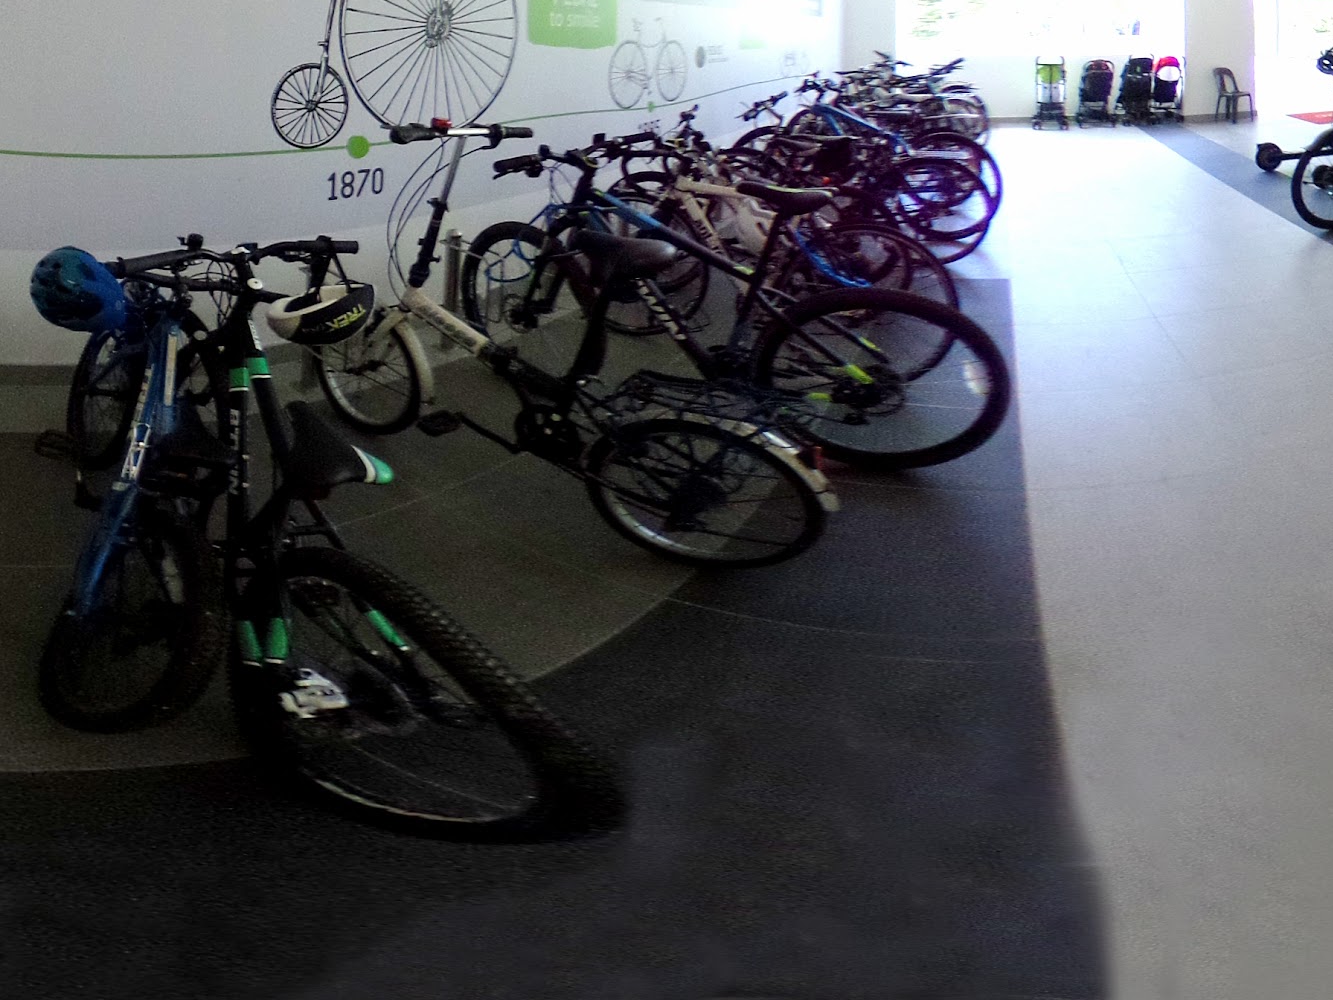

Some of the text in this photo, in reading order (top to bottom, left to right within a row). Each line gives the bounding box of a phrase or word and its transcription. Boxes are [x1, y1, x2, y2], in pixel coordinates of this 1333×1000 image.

[550, 12, 565, 27] to
[327, 167, 384, 201] 1870
[325, 303, 366, 328] TREK
